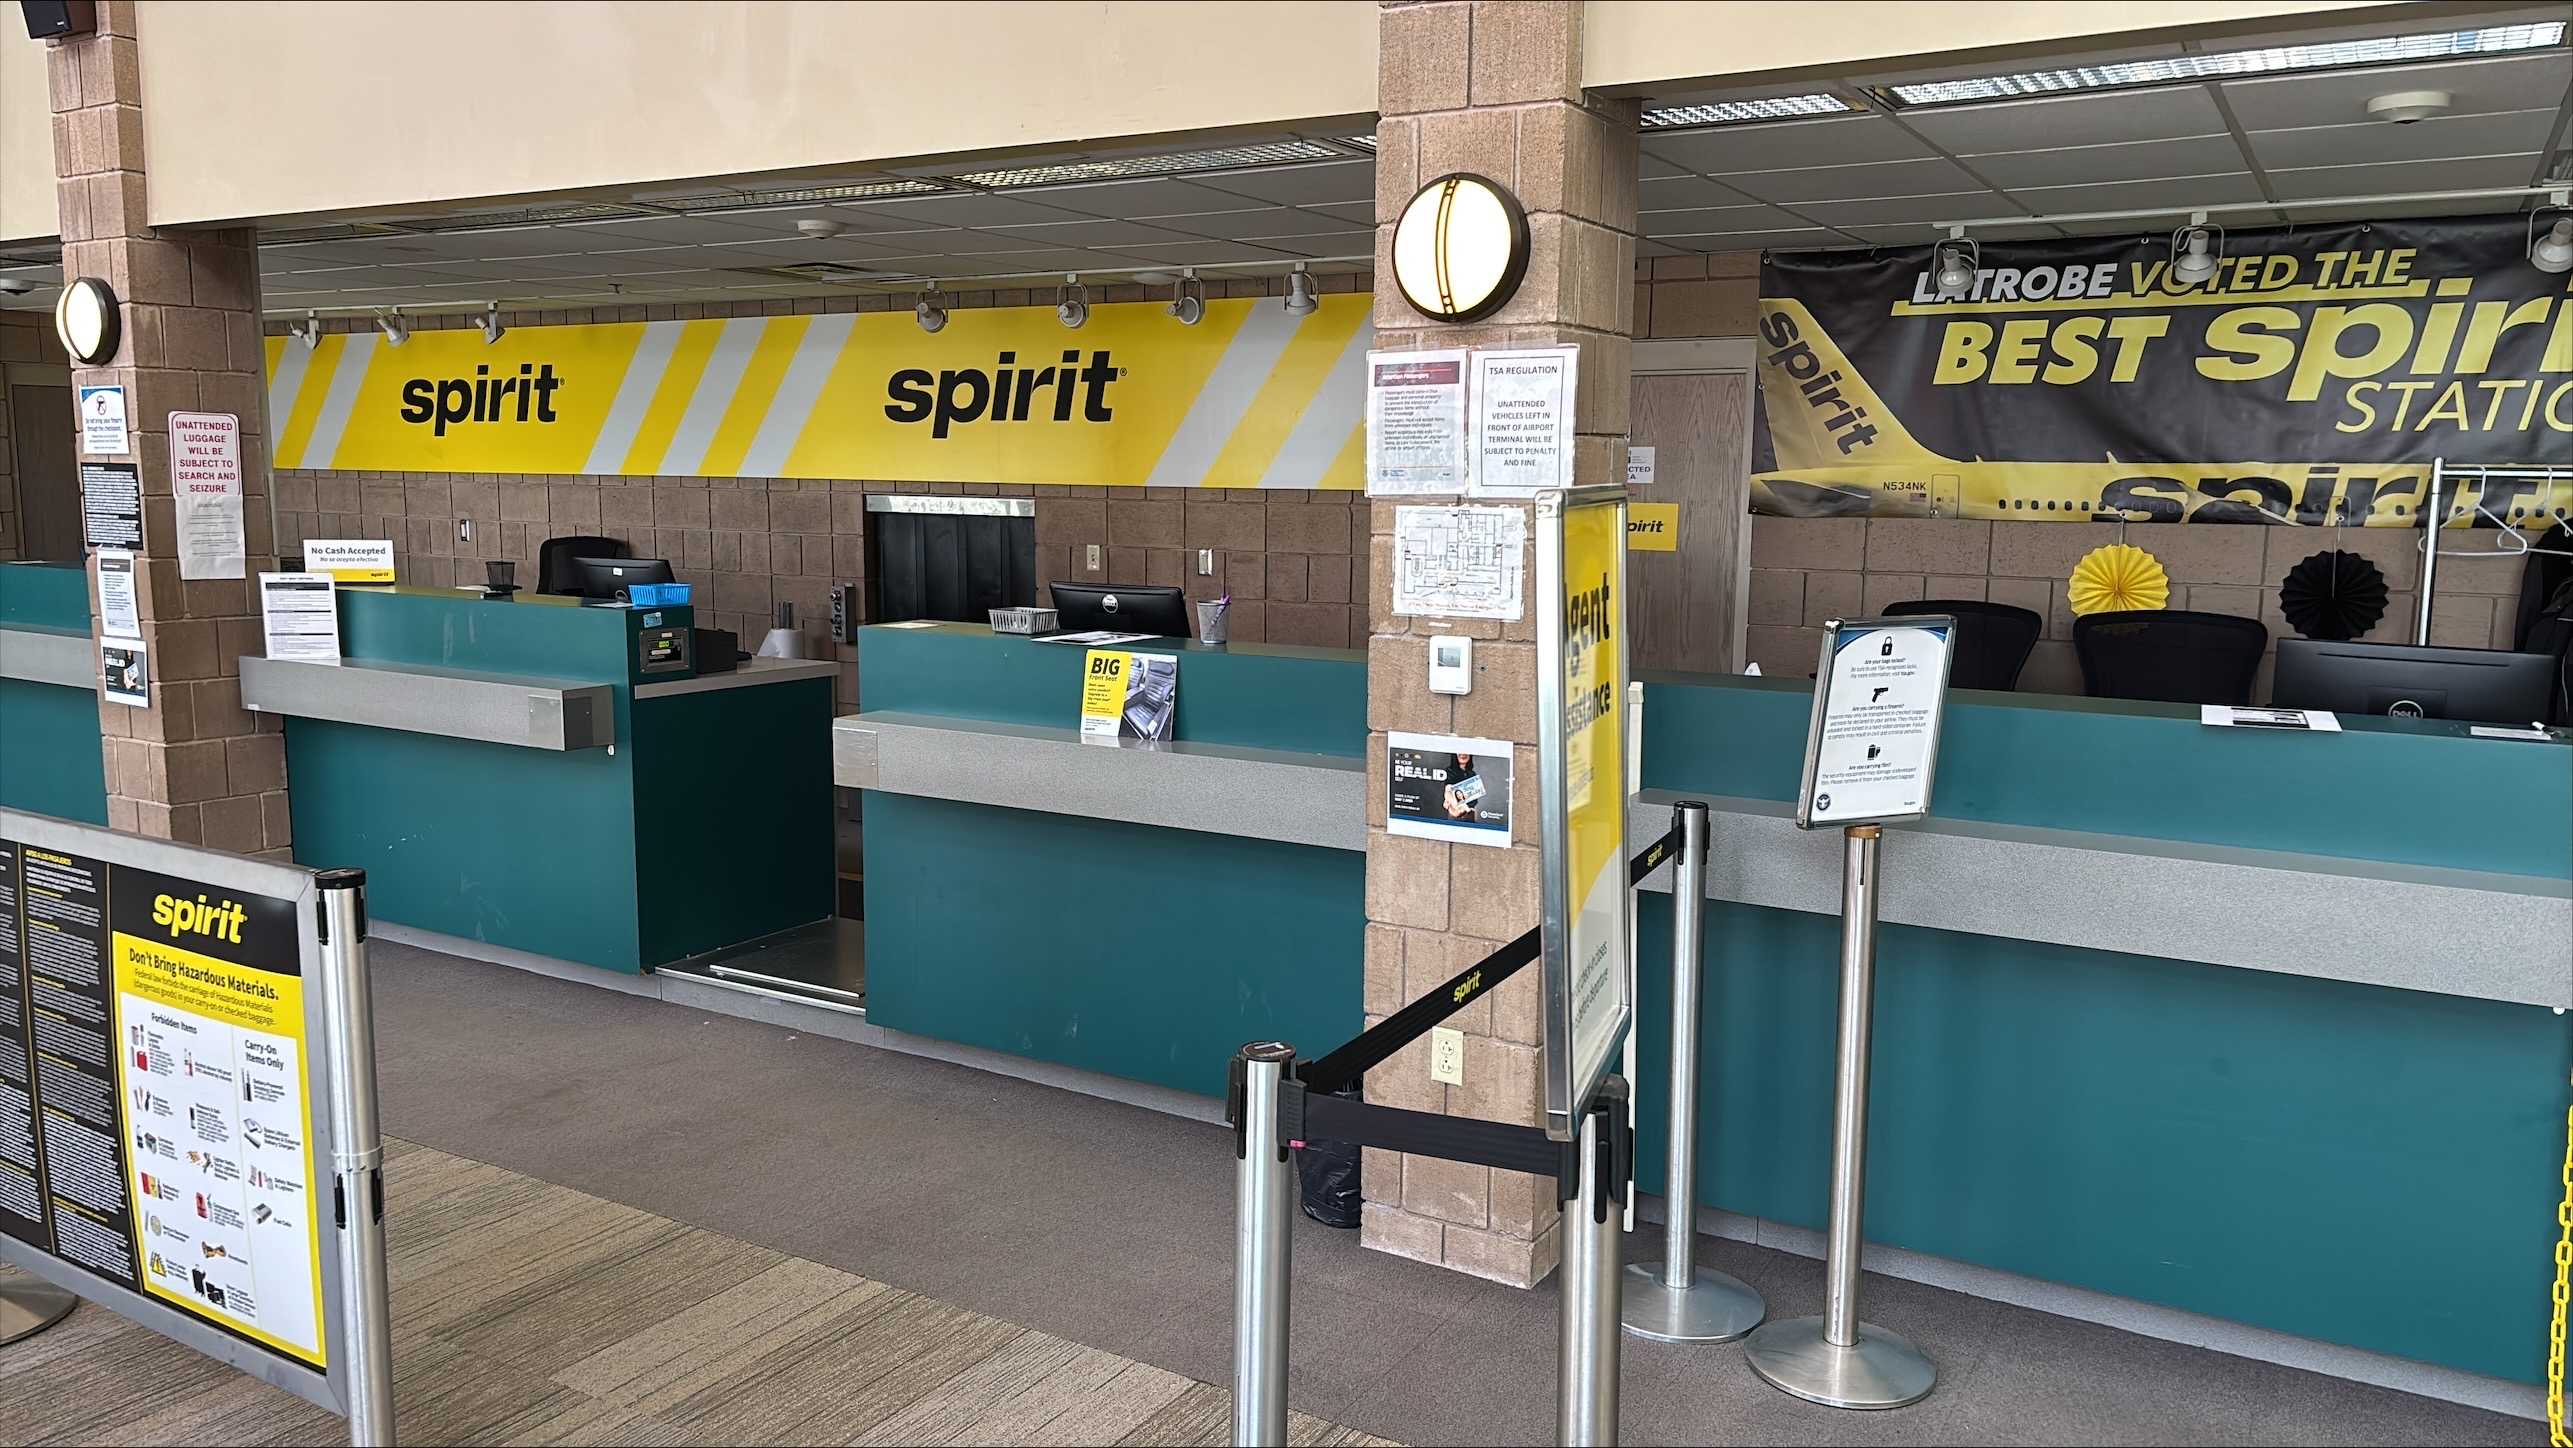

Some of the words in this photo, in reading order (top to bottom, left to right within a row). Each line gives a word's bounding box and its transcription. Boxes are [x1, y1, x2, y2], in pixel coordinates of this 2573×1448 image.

[1912, 263, 2119, 303] LTROBE
[2315, 248, 2417, 287] THE
[1932, 314, 2171, 385] BEST
[2195, 277, 2573, 401] spiri
[1489, 367, 1504, 375] TSA
[1506, 366, 1558, 375] REGULATION
[1760, 312, 1879, 456] spirit
[400, 363, 560, 437] spirit
[884, 350, 1120, 439] spirit
[1497, 400, 1546, 408] UNATTENDED
[1492, 412, 1524, 420] VEHICLES
[175, 421, 233, 431] UNATTENDED
[1487, 424, 1511, 432] FRONT
[1523, 423, 1554, 431] AIRPORT
[183, 434, 227, 443] LUGGAGE
[1488, 435, 1524, 443] TERMINAL
[1525, 435, 1542, 443] WILL
[1544, 435, 1552, 443] BE
[188, 447, 209, 455] WILL
[212, 447, 224, 455] BE
[1484, 447, 1513, 455] SUBJECT
[1514, 447, 1524, 455] TO
[1525, 447, 1557, 455] PENALTY
[179, 459, 219, 468] SUBJECT
[221, 459, 234, 468] TO
[1503, 459, 1519, 467] AND
[1520, 459, 1536, 467] FINE
[178, 471, 215, 480] SEARCH
[217, 472, 236, 480] AND
[189, 484, 227, 493] SEIZURE
[1883, 481, 1927, 491] N534NK
[1627, 519, 1664, 533] pirit
[311, 547, 323, 555] No
[325, 547, 346, 555] Cash
[347, 547, 386, 556] Accepted
[1562, 571, 1610, 678] gent
[1090, 657, 1121, 676] BIG
[1394, 765, 1432, 780] REAL
[1433, 768, 1448, 781] ID
[1647, 843, 1664, 867] spirit
[152, 893, 246, 944] spirit
[129, 947, 153, 964] Don't
[154, 955, 177, 978] Bring
[178, 960, 226, 989] Hazardous
[227, 974, 279, 1001] Materials.
[1453, 970, 1482, 1003] spirit
[151, 1013, 180, 1030] Forbidden
[181, 1019, 198, 1034] Items
[244, 1039, 278, 1055] Carry-On
[245, 1051, 265, 1066] Items
[266, 1056, 285, 1071] Only
